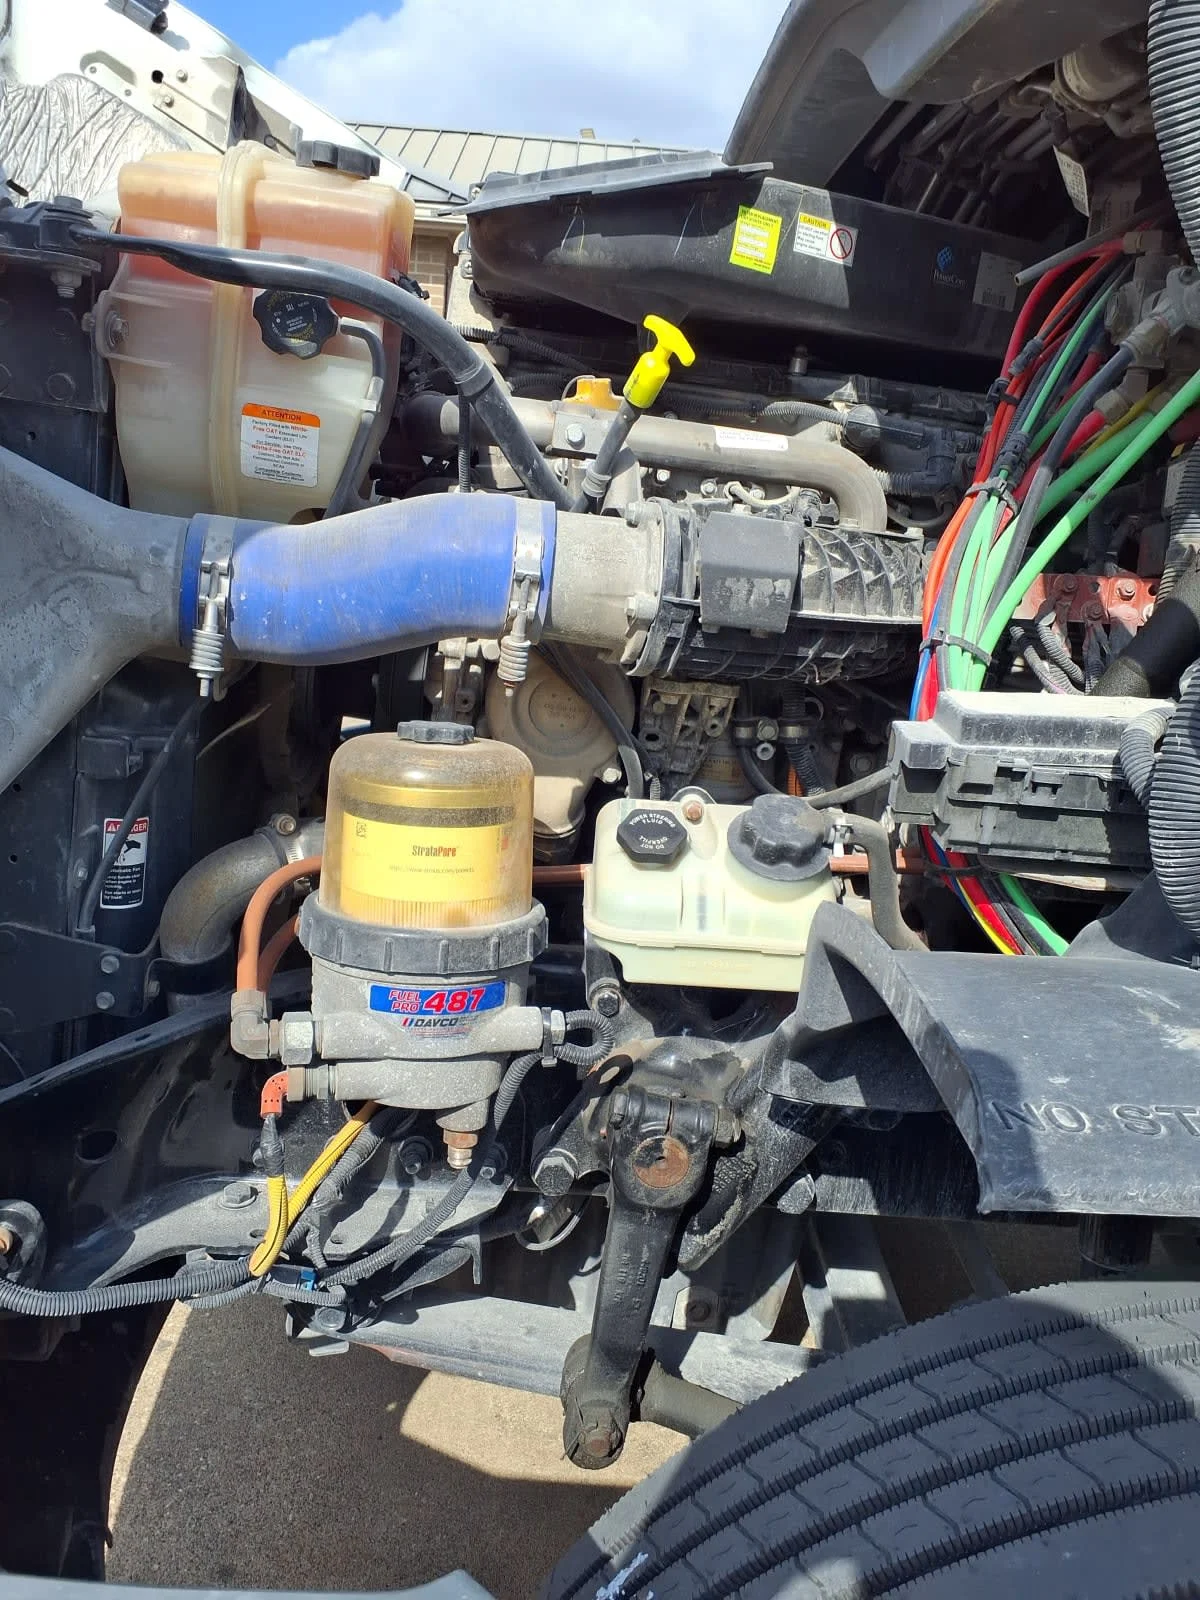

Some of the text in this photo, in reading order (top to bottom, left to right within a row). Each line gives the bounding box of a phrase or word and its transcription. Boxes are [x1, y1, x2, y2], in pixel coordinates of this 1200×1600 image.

[262, 409, 302, 421] ATTENTION
[629, 813, 676, 828] POWER STEERING
[411, 844, 457, 857] StrataPore
[388, 986, 486, 1014] FUEL 487
[391, 1001, 420, 1014] PRO
[413, 1017, 460, 1028] DAVCO
[990, 1100, 1088, 1134] NO
